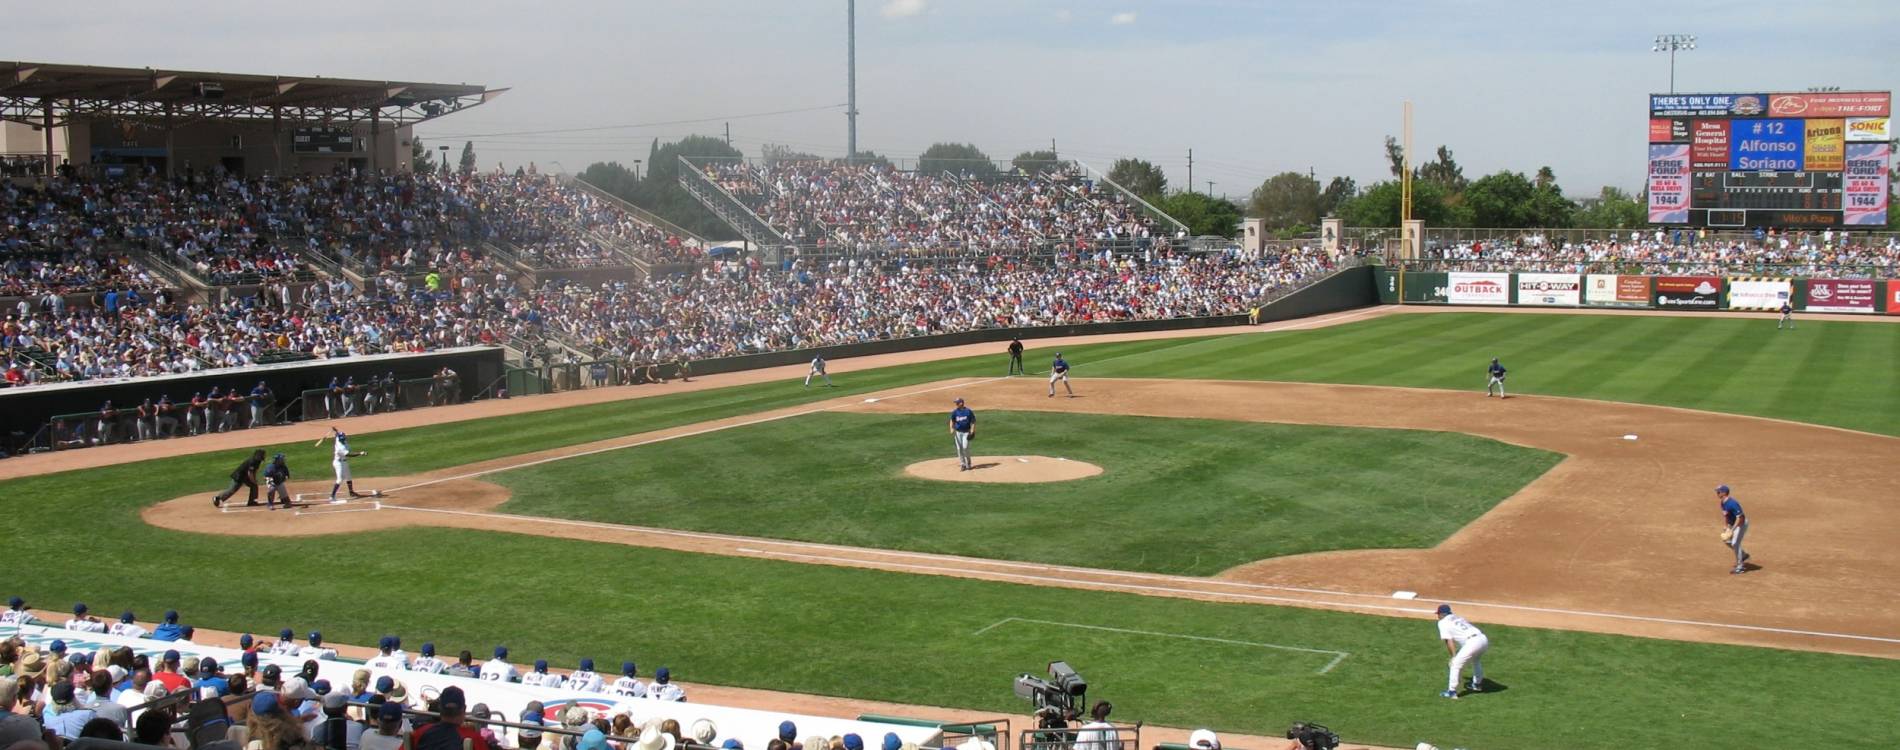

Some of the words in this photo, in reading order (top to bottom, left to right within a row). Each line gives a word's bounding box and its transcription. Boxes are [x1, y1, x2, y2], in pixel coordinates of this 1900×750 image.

[1653, 97, 1687, 105] THERE'S
[1752, 122, 1761, 134] #
[1766, 122, 1784, 134] 12
[1850, 122, 1885, 131] SONIC
[1807, 126, 1841, 138] Arizona
[1739, 140, 1796, 152] Alfonso
[1739, 156, 1796, 168] Soriano
[1656, 196, 1678, 205] 1944
[1852, 197, 1876, 206] 1944
